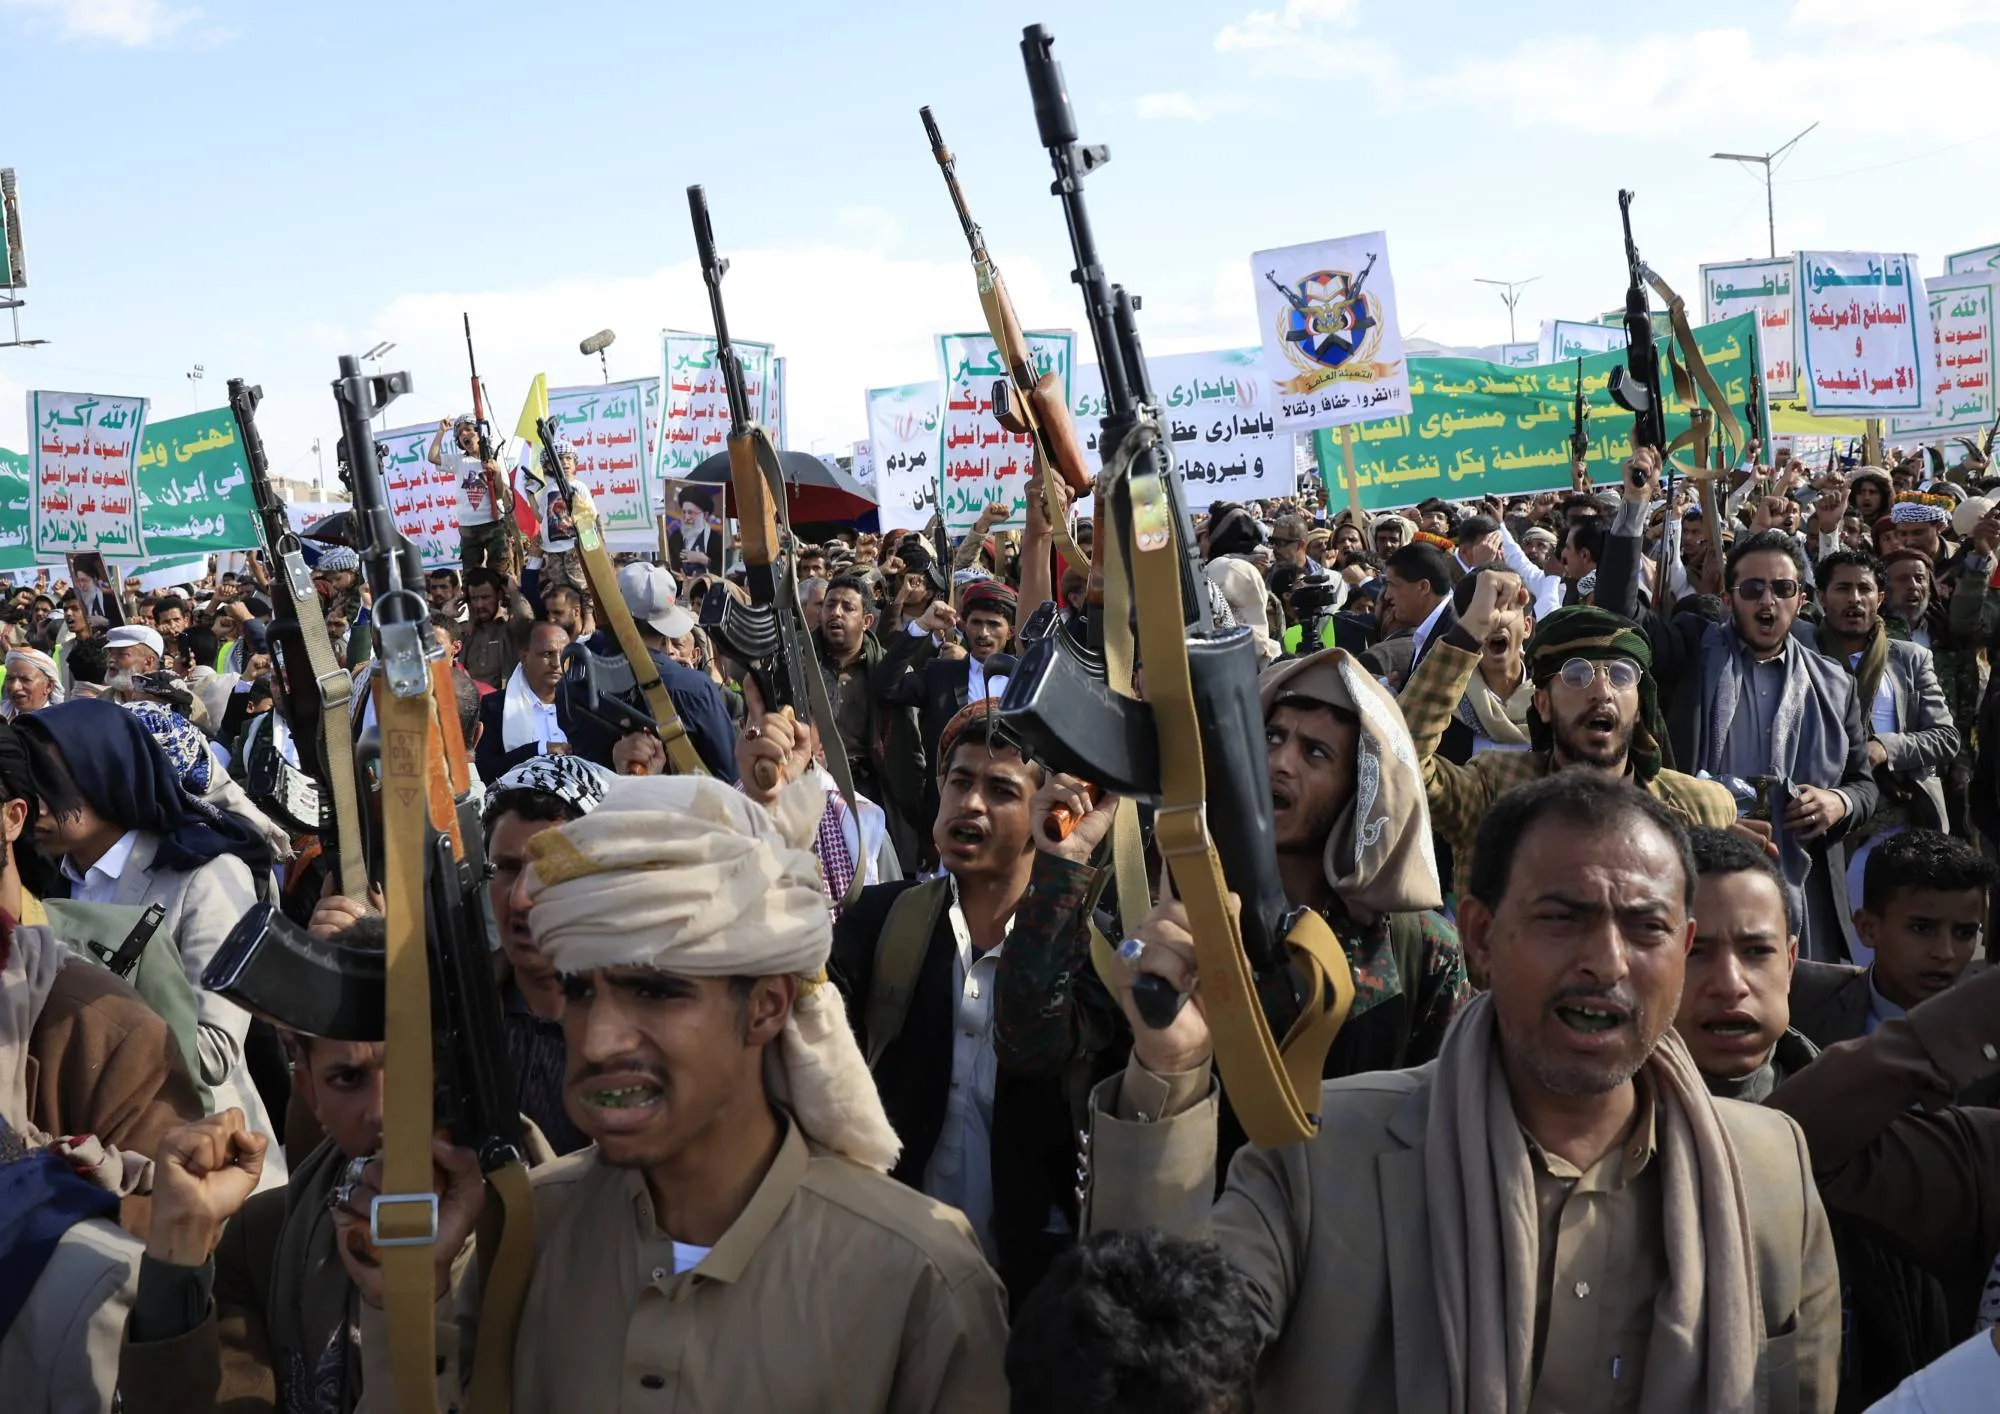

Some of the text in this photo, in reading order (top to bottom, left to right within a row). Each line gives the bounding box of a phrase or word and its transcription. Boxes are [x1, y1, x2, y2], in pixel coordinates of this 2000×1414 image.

[1807, 259, 1904, 294] قاطعوا
[1710, 272, 1791, 306] قاطعوا
[1809, 298, 1906, 330] البضائع الأمريكية
[1951, 295, 1986, 318] الله
[1855, 336, 1863, 358] و
[1945, 325, 1987, 345] الموت
[953, 350, 1003, 386] كبر
[1946, 349, 1988, 369] الموت
[672, 376, 716, 396] لأمريكا
[1816, 366, 1914, 396] الإسرائيلية
[1956, 372, 1989, 389] اللعنة
[41, 397, 137, 433] الله أكبر
[602, 397, 635, 418] الله
[668, 401, 715, 421] لإسرائيل
[1517, 400, 1560, 429] على
[1949, 392, 1989, 420] النصر
[1419, 408, 1506, 439] مستوى
[42, 434, 130, 460] الموت لأمريكا
[174, 421, 235, 462] نهنئ
[597, 428, 637, 448] الموت
[665, 426, 722, 446] على اليهود
[385, 436, 426, 472] أكبر
[598, 454, 638, 473] الموت
[886, 451, 927, 477] مردم
[1448, 448, 1486, 482] بكل
[41, 464, 88, 488] لإسرائيل
[92, 469, 129, 488] الموت
[388, 468, 429, 491] لأمريكا
[946, 456, 990, 482] اليهود
[994, 456, 1017, 480] على
[1254, 456, 1264, 479] و
[1337, 453, 1441, 490] تشكيلاتا
[214, 462, 245, 501] في
[610, 479, 640, 494] اللعنة
[41, 494, 73, 515] اليهود
[77, 495, 96, 516] على
[101, 495, 131, 515] اللعنة
[393, 494, 433, 517] لإسرائيل
[606, 500, 643, 526] النصر
[94, 520, 133, 549] النصر
[430, 517, 445, 535] على
